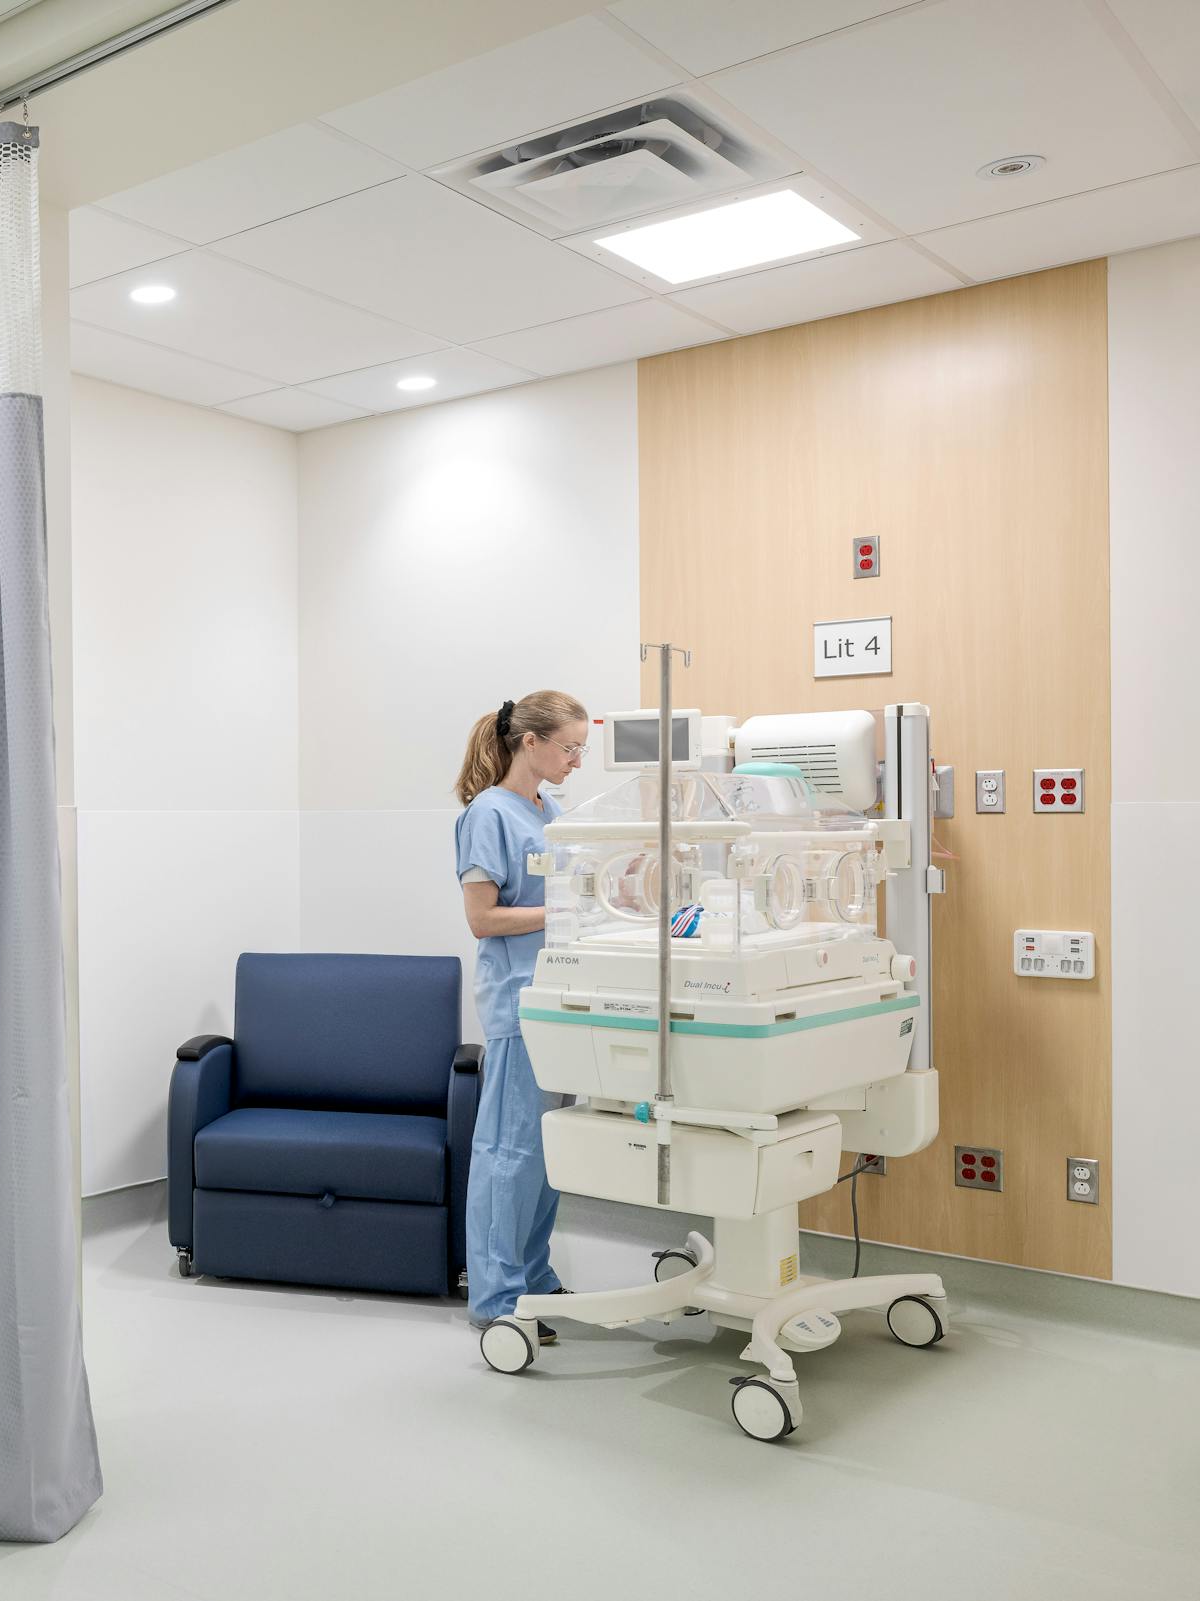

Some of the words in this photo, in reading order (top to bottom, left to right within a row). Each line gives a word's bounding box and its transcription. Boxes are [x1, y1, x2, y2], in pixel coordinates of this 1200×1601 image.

[824, 638, 855, 659] Lit
[864, 635, 881, 656] 4
[554, 956, 579, 965] ATOM
[683, 980, 703, 989] Dual
